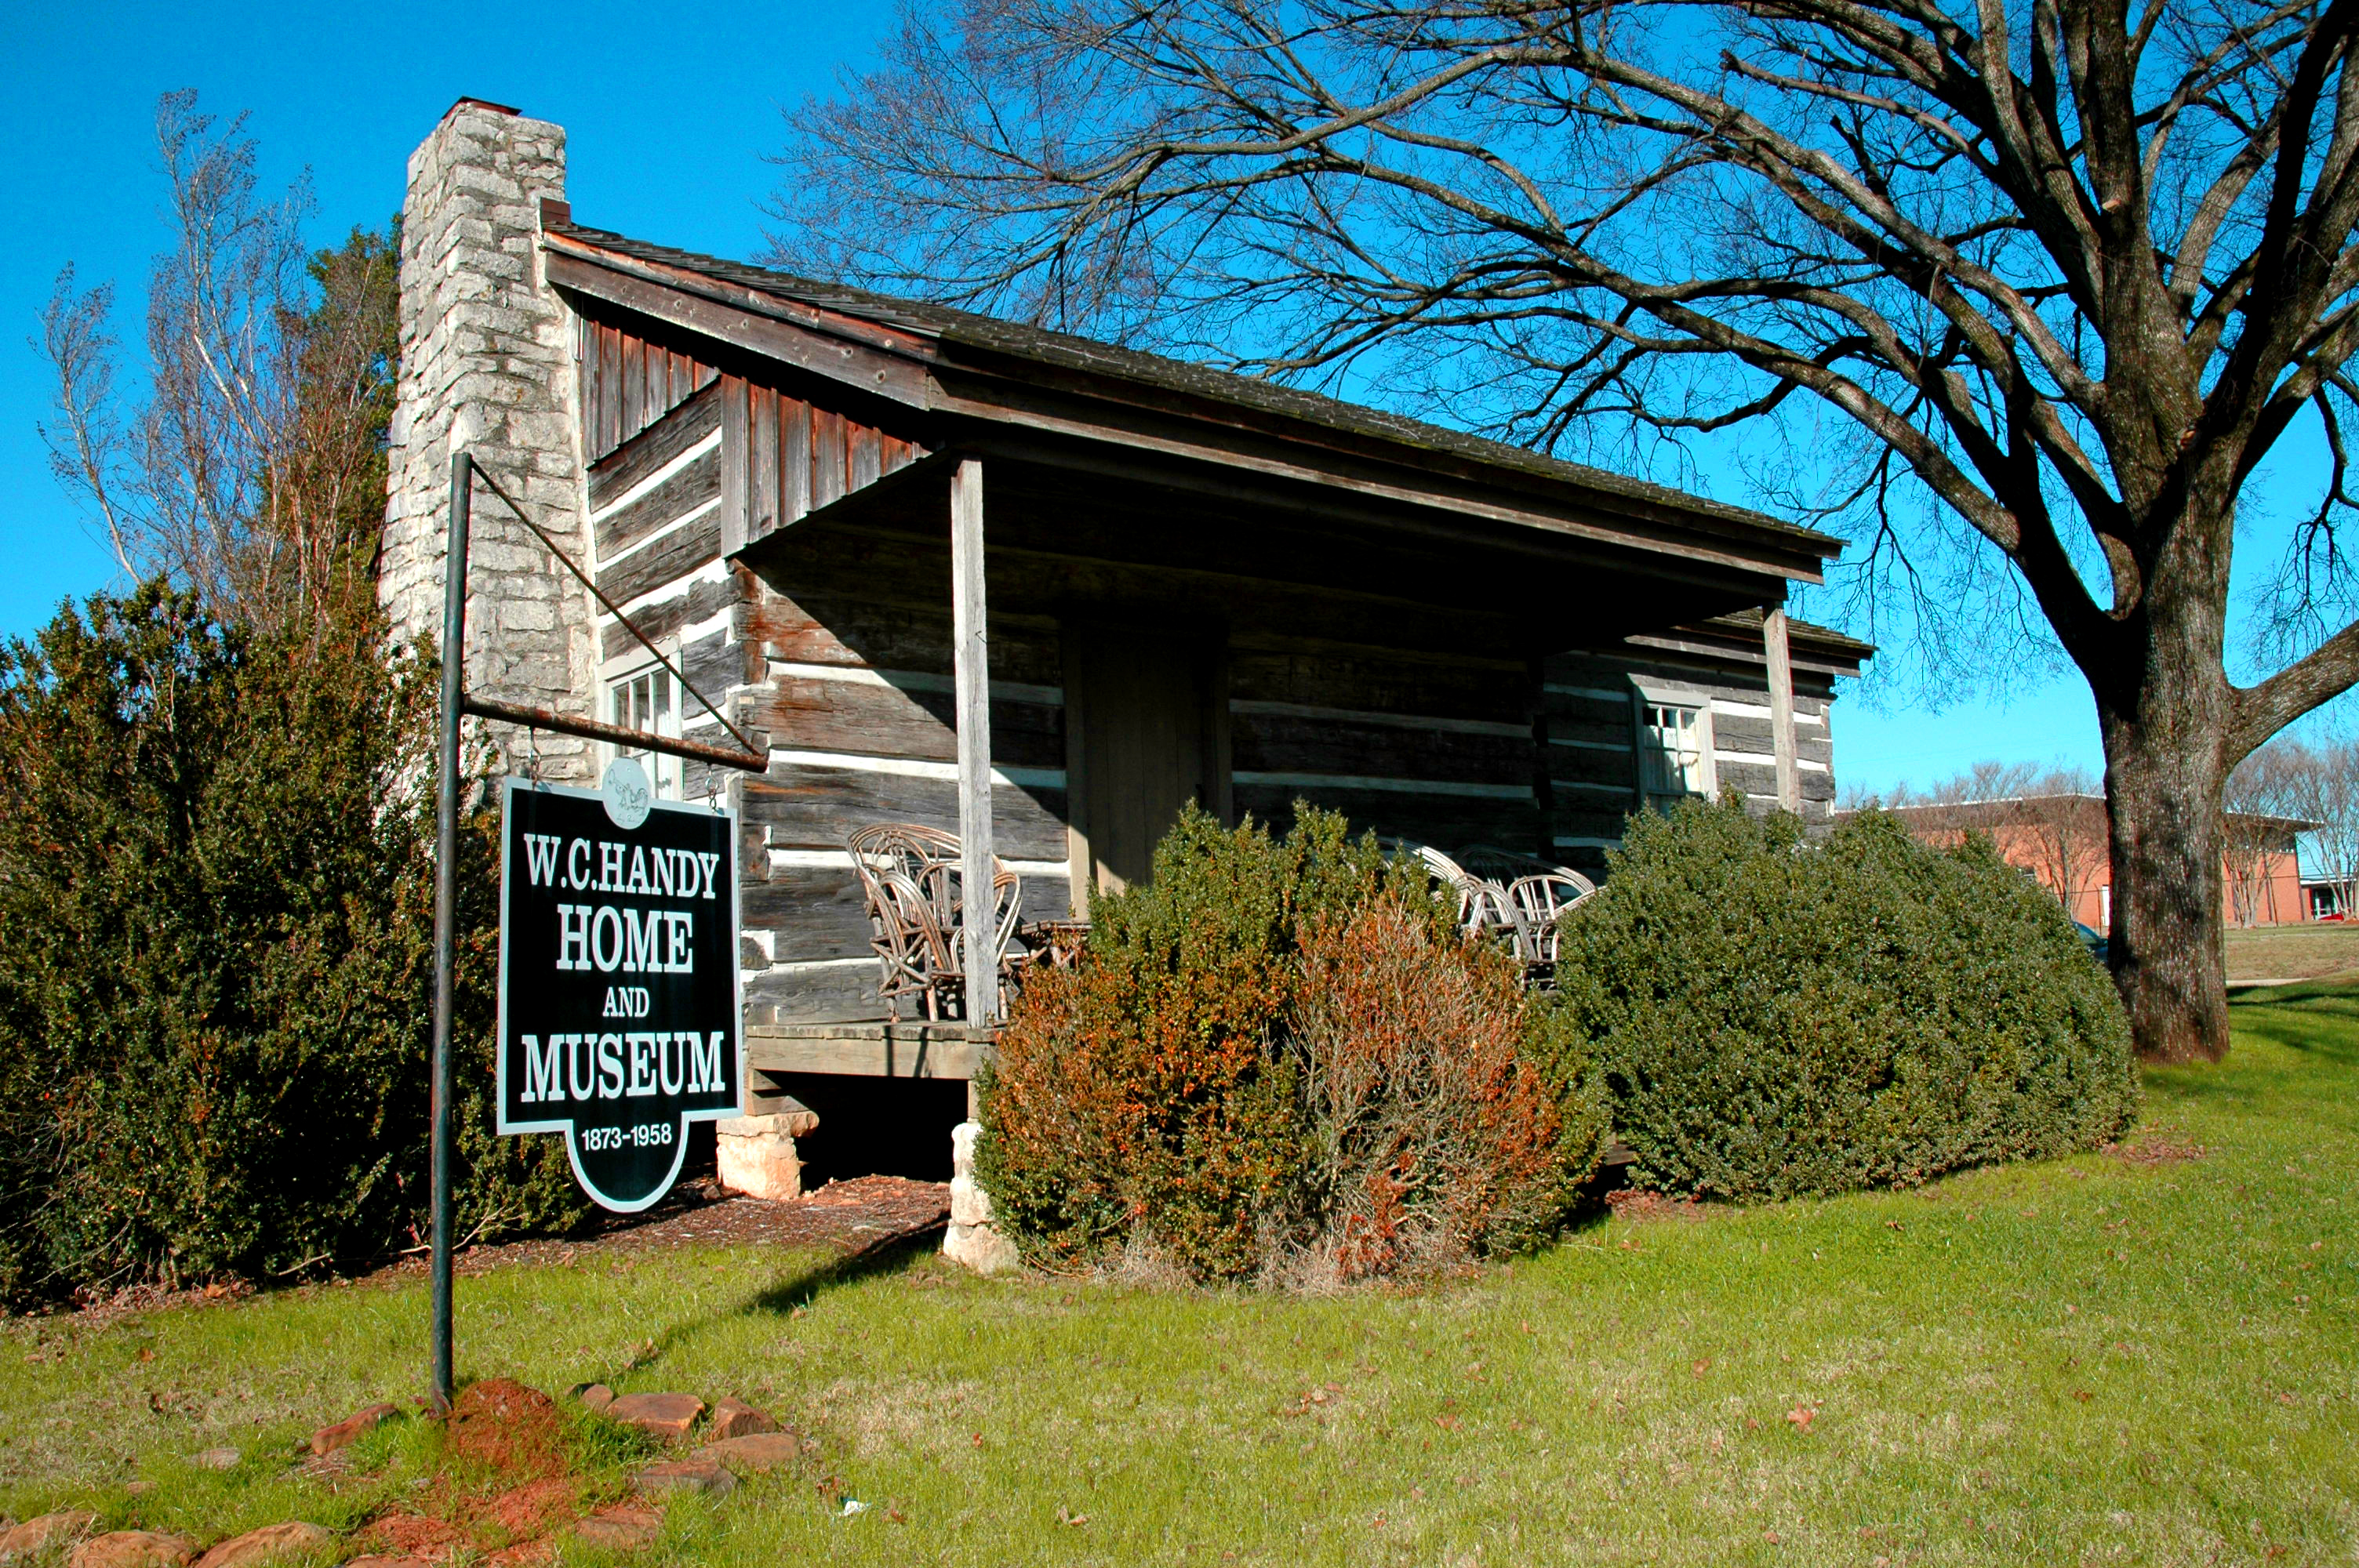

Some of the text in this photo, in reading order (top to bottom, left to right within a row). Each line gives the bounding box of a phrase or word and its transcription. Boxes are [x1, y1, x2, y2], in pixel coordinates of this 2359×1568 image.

[556, 904, 692, 973] HOME
[602, 986, 649, 1018] AND
[521, 1031, 725, 1102] MUSEUM
[581, 1123, 672, 1151] 1873-1958
